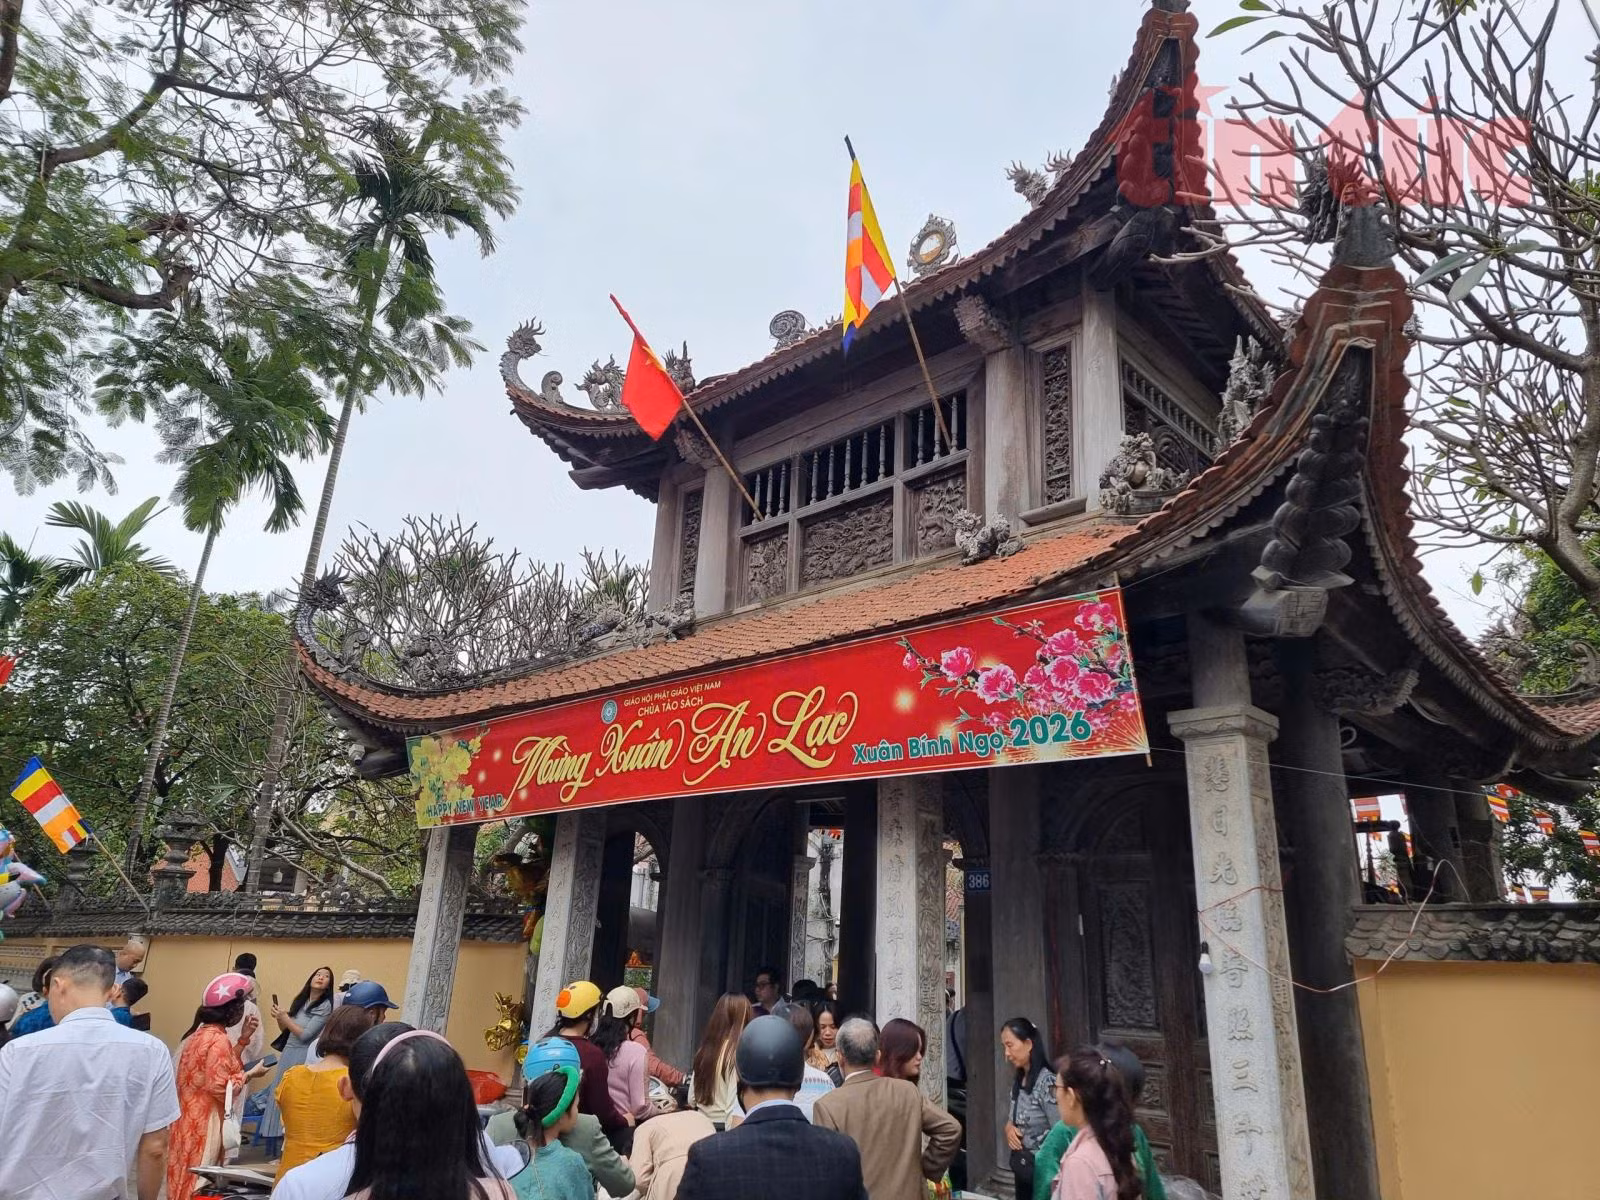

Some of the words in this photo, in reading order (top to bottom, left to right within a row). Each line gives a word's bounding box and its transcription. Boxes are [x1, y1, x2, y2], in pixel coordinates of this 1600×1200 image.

[624, 697, 640, 707] GIÁO
[641, 693, 653, 704] HỘI
[653, 691, 670, 701] PHẬT
[671, 687, 688, 697] GIÁO
[690, 683, 704, 694] VIỆT
[705, 681, 721, 691] NAM
[637, 702, 660, 717] CHÙA
[661, 698, 679, 713] TẢO
[680, 695, 704, 709] SÁCH
[495, 735, 595, 812] Mừng
[595, 719, 686, 778] Xuân
[682, 700, 767, 786] An
[767, 685, 859, 769] Lạc
[852, 741, 904, 765] Xuân
[907, 733, 953, 759] Bính
[957, 730, 1005, 757] Ngọ
[1008, 710, 1093, 748] 2026
[426, 801, 453, 818] HAPPY
[454, 798, 476, 814] NEW
[477, 793, 505, 812] YEAR
[968, 873, 989, 888] 386
